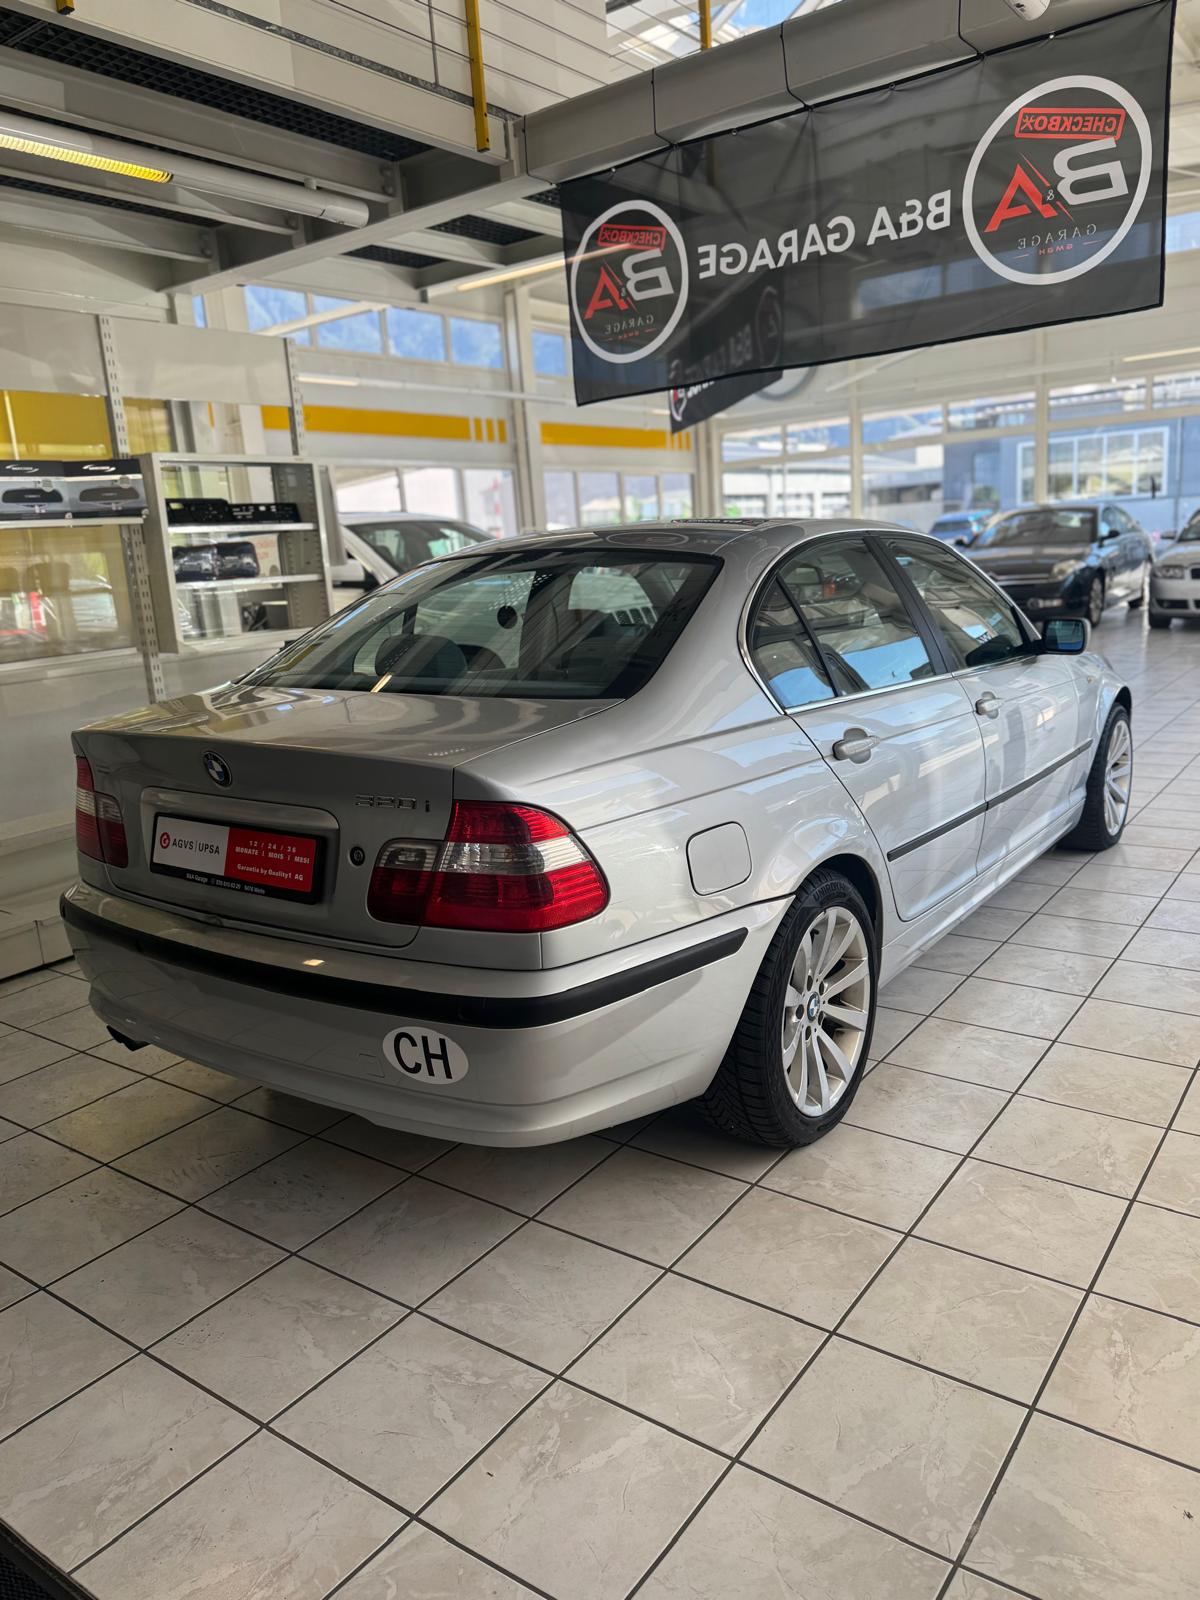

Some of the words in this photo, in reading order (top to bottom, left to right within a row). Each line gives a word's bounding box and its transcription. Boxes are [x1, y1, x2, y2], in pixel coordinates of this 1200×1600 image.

[172, 837, 195, 851] AGVS
[198, 841, 221, 856] UPSA
[249, 840, 259, 848] 12
[234, 846, 260, 857] MONATE
[267, 852, 285, 861] MOIS
[260, 867, 268, 876] by
[294, 873, 305, 882] AG
[393, 1031, 453, 1080] CH
